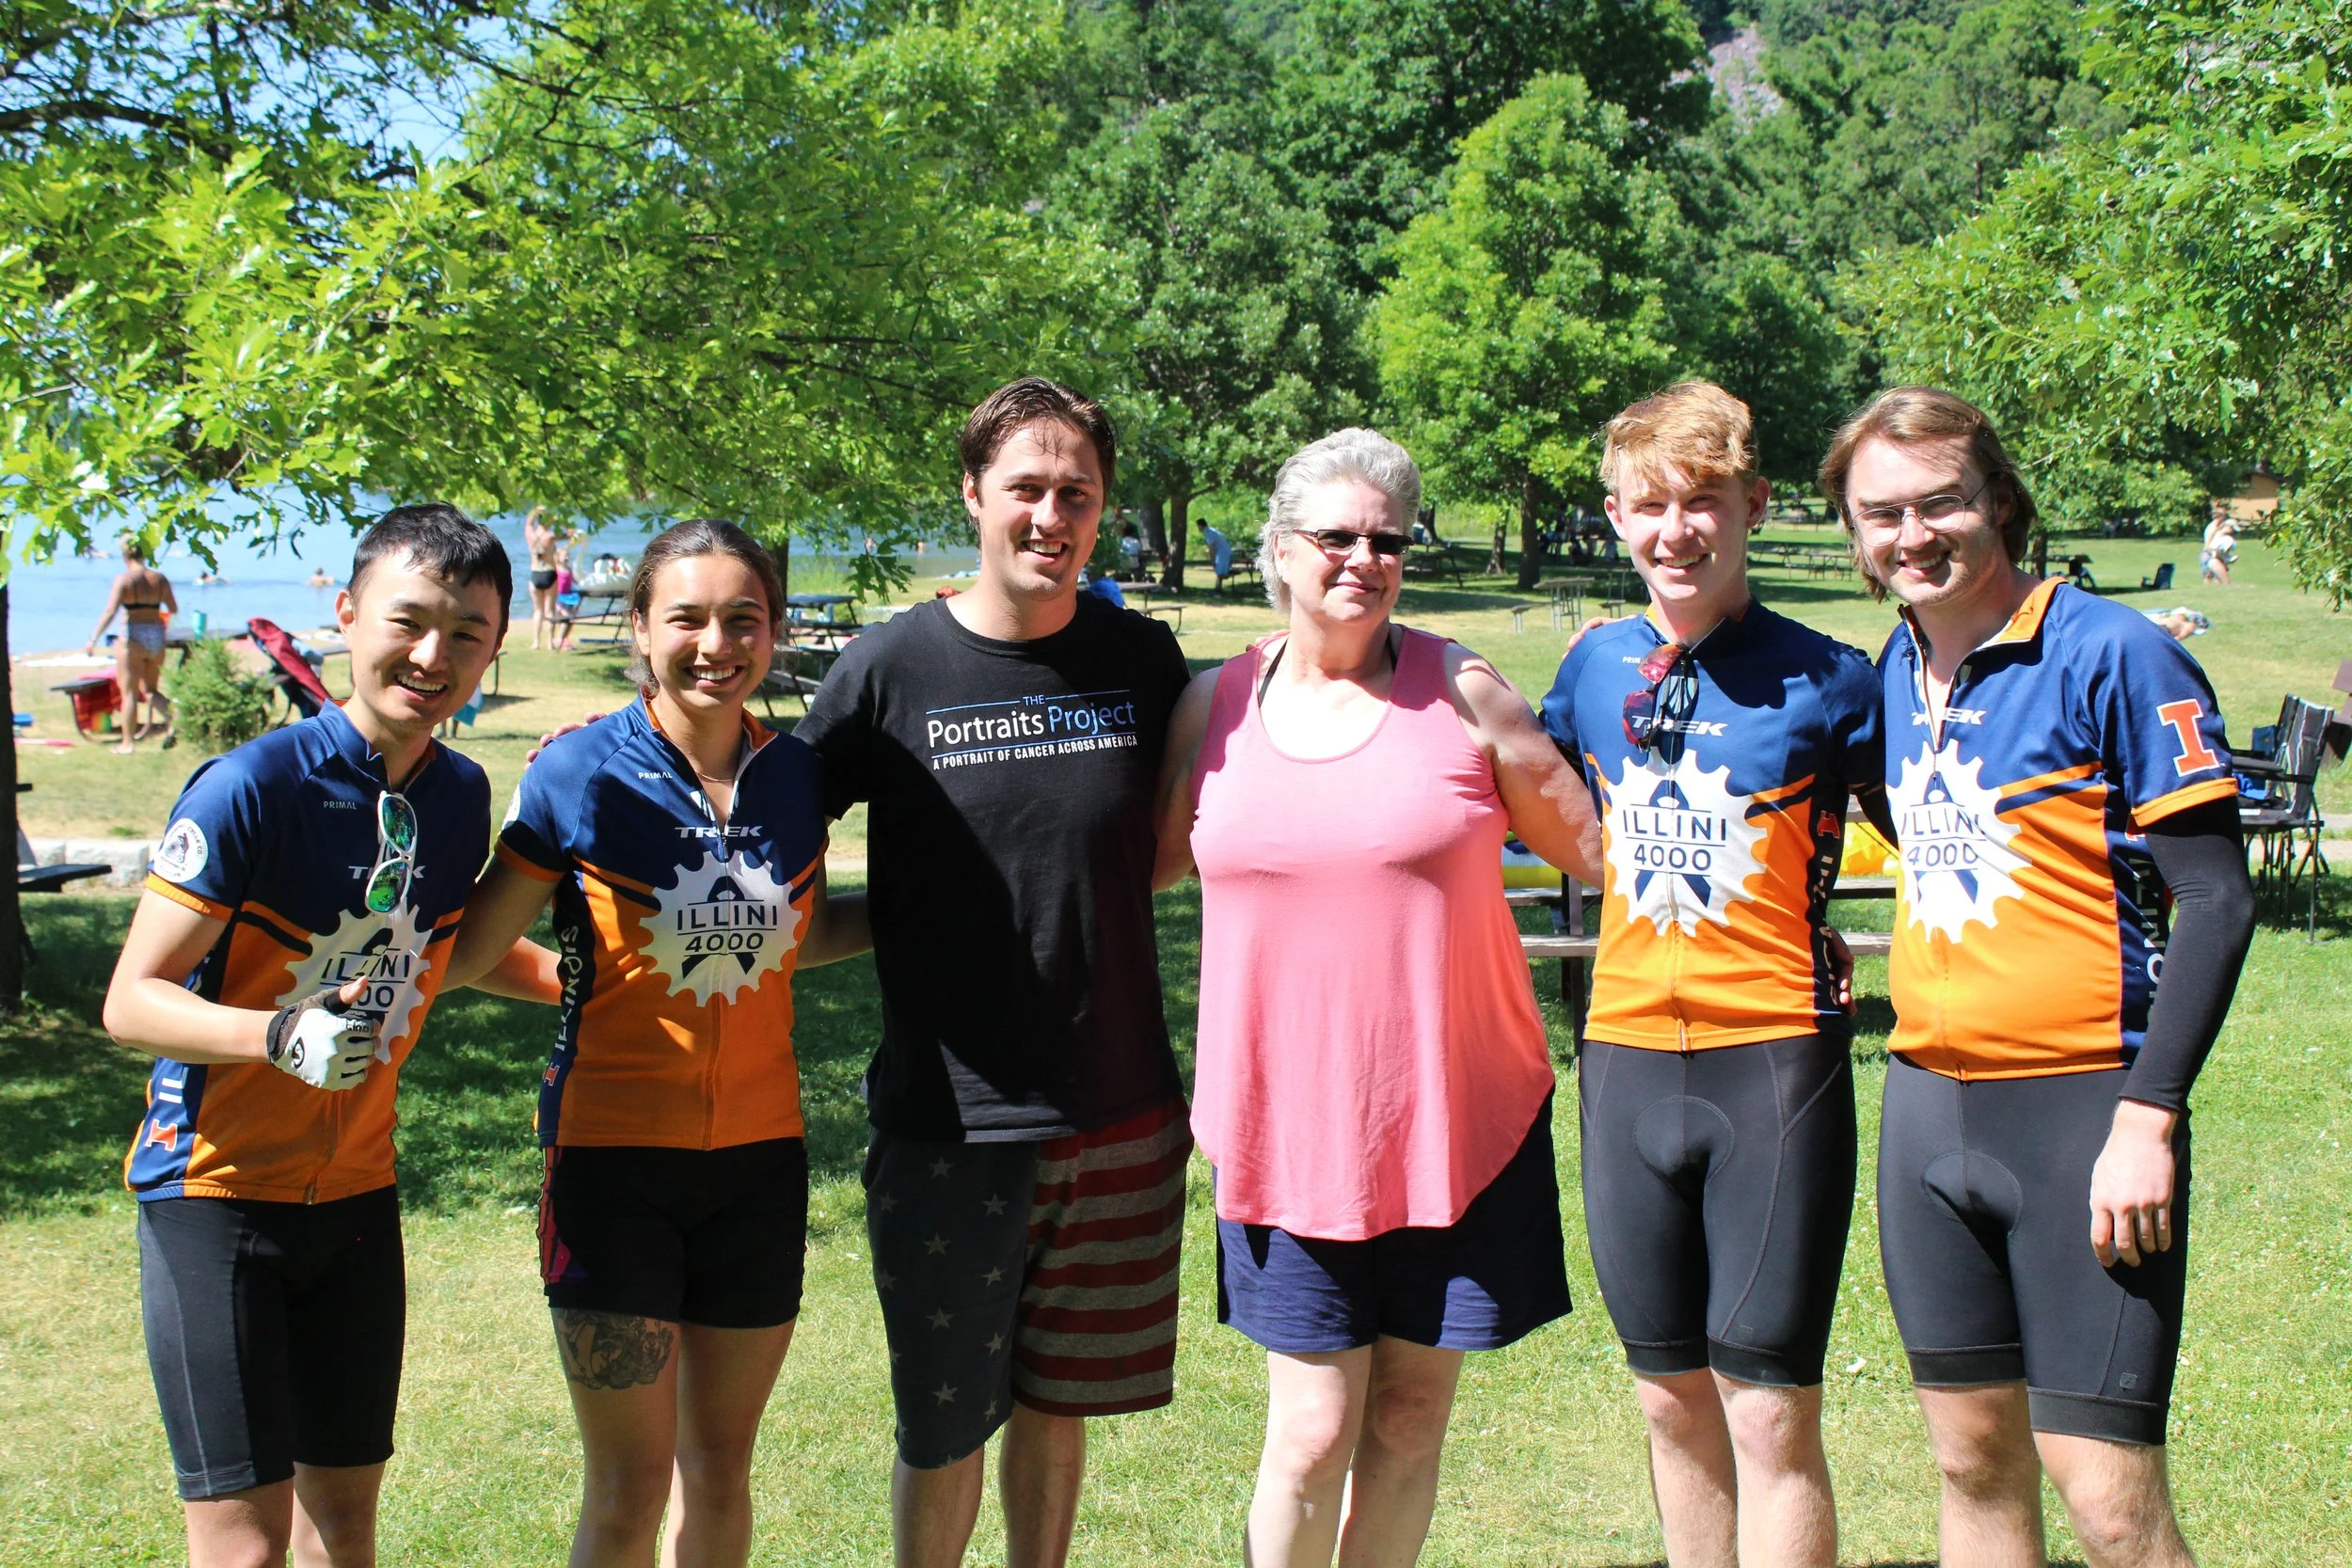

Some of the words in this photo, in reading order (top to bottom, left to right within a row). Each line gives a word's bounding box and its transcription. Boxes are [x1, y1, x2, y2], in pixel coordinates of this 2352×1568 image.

[1622, 656, 1642, 664] PRIM
[1023, 694, 1045, 705] THE
[927, 710, 1044, 748] Portraits
[1047, 702, 1136, 735] Project
[2156, 698, 2220, 777] I
[933, 758, 940, 770] A
[943, 751, 993, 769] PORTRAIT
[997, 749, 1011, 761] OF
[1014, 743, 1056, 760] CANCER
[1057, 738, 1096, 754] ACROSS
[1098, 736, 1137, 752] AMERICA
[638, 771, 674, 780] PRIMAL
[323, 800, 358, 810] PRIMAL
[674, 825, 764, 839] TREK
[1623, 809, 1726, 841] ILLINI
[1634, 844, 1711, 871] 4000
[348, 865, 426, 879] TK
[676, 904, 778, 930] ILLINI
[684, 932, 764, 952] 4000
